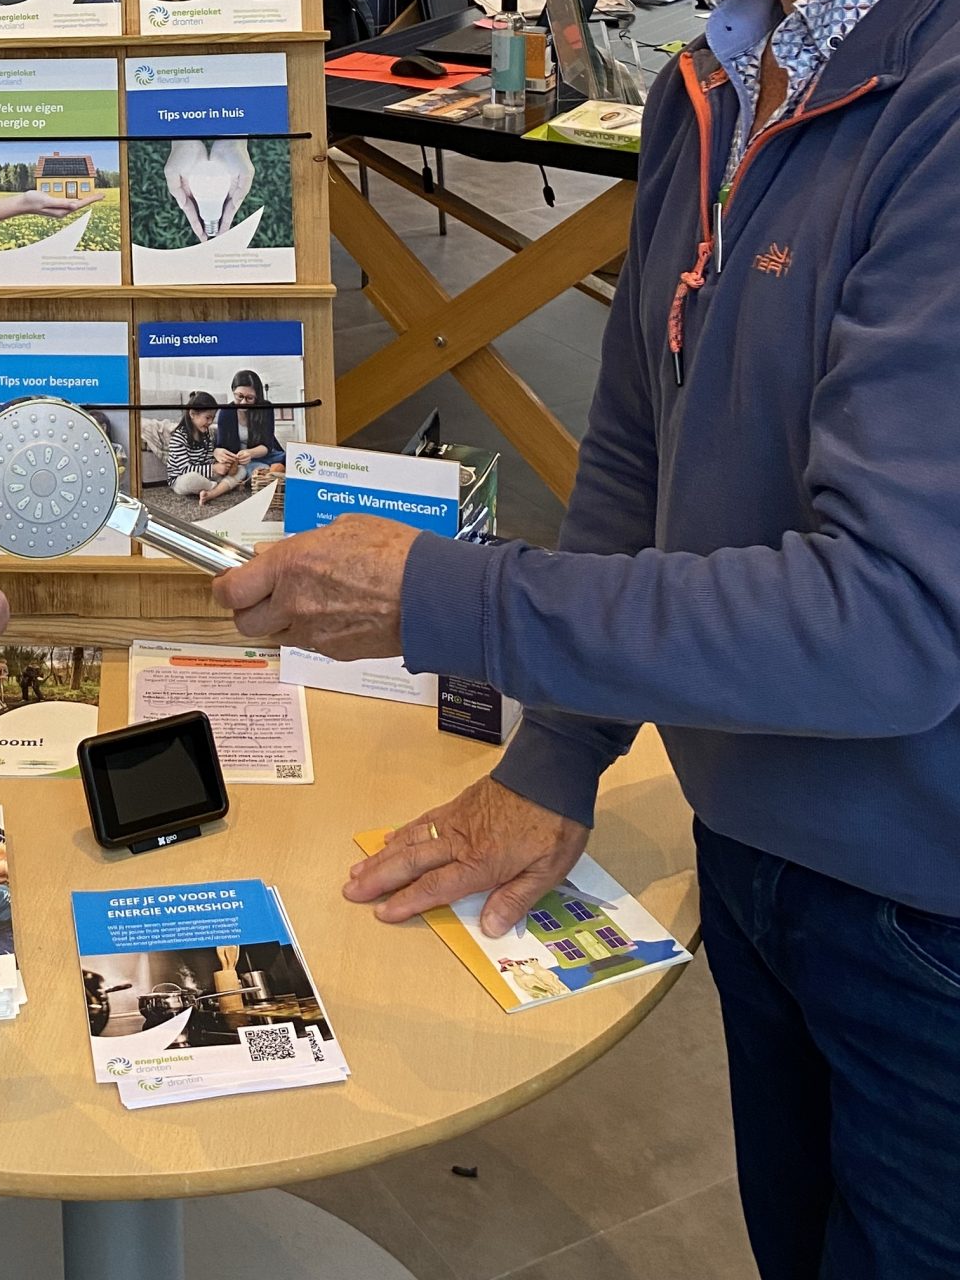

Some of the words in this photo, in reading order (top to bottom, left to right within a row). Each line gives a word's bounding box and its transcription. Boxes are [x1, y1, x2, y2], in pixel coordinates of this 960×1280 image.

[171, 8, 222, 19] energieloket
[171, 16, 204, 26] dronten
[156, 66, 204, 77] energieloket
[156, 75, 190, 84] flevoland
[16, 105, 33, 114] uw
[35, 102, 64, 115] eigen
[158, 109, 180, 122] Tips
[182, 109, 206, 119] voor
[209, 108, 220, 118] in
[222, 107, 245, 118] huis
[32, 118, 46, 129] op
[573, 129, 615, 141] RADIATOR
[149, 334, 182, 347] Zuinig
[183, 333, 218, 345] stoken
[22, 378, 48, 387] voor
[49, 375, 99, 388] besparen
[318, 459, 369, 472] energieloket
[318, 469, 348, 479] dronten
[317, 488, 355, 505] Gratis
[358, 493, 448, 517] Warmtescan?
[316, 512, 332, 521] Meld
[166, 833, 177, 844] geo
[109, 897, 140, 907] GEEF
[142, 895, 156, 906] JE
[158, 894, 176, 903] OP
[178, 891, 217, 901] VOOR
[219, 889, 237, 898] DE
[107, 907, 162, 918] ENERGIE
[164, 901, 244, 914] WORKSHOP!
[134, 1054, 194, 1066] energieloket
[135, 1064, 172, 1074] dronten
[167, 1075, 204, 1088] dronten
